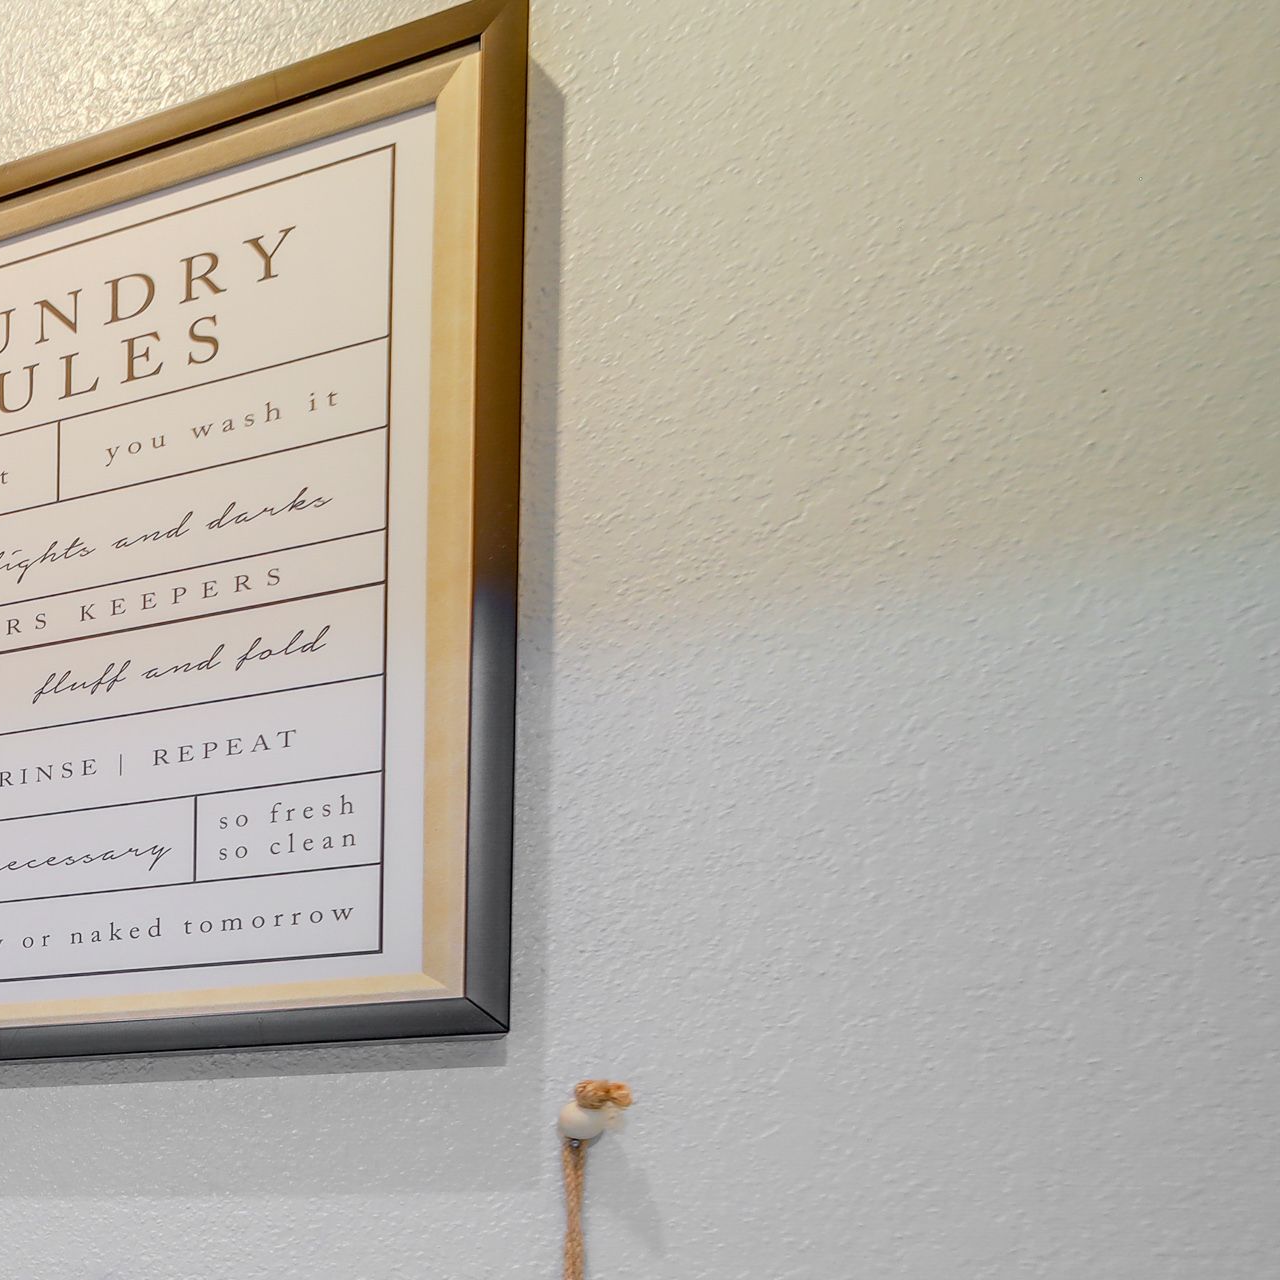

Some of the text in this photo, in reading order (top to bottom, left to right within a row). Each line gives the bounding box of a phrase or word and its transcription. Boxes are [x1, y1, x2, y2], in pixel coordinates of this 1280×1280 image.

[104, 391, 339, 468] you wash it
[110, 510, 194, 550] and
[205, 486, 334, 530] darks
[79, 567, 281, 623] KEEPERS
[31, 624, 331, 705] fluff and fold
[152, 728, 297, 767] REPEAT
[219, 794, 355, 830] so fresh
[218, 832, 357, 861] so clean
[22, 934, 51, 949] or
[70, 917, 162, 945] naked
[183, 906, 354, 935] tomorrow
